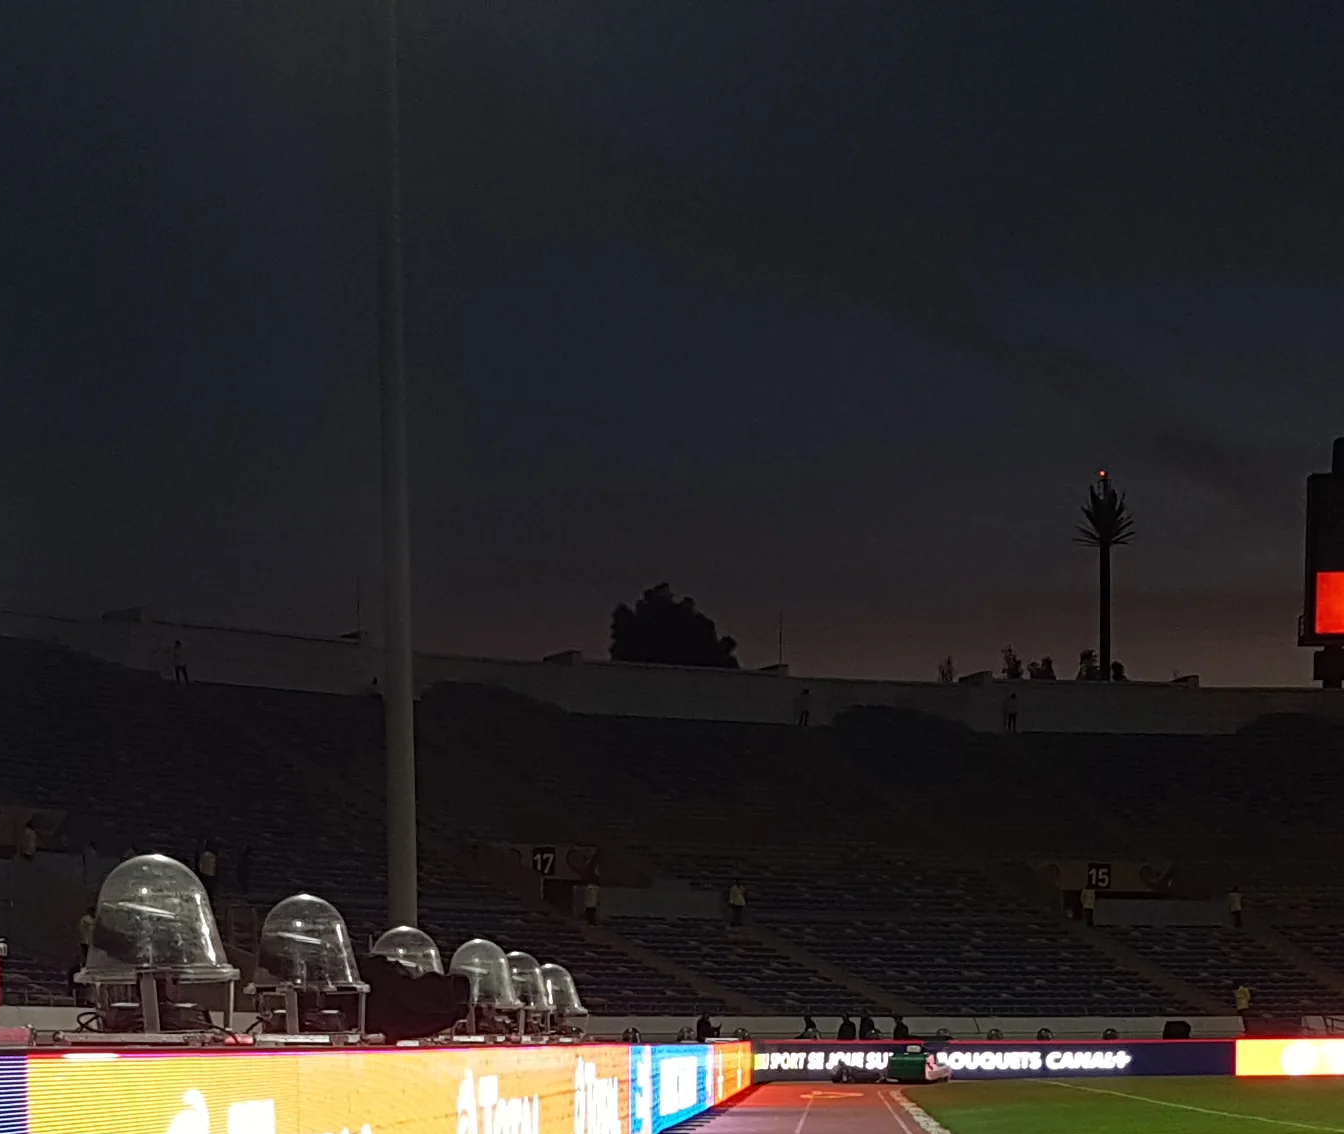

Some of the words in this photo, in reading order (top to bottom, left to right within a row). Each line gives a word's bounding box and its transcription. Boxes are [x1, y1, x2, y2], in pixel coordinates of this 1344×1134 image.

[533, 854, 555, 876] 17
[1088, 867, 1110, 889] 15
[807, 1052, 824, 1069] SE
[866, 1052, 893, 1069] SU
